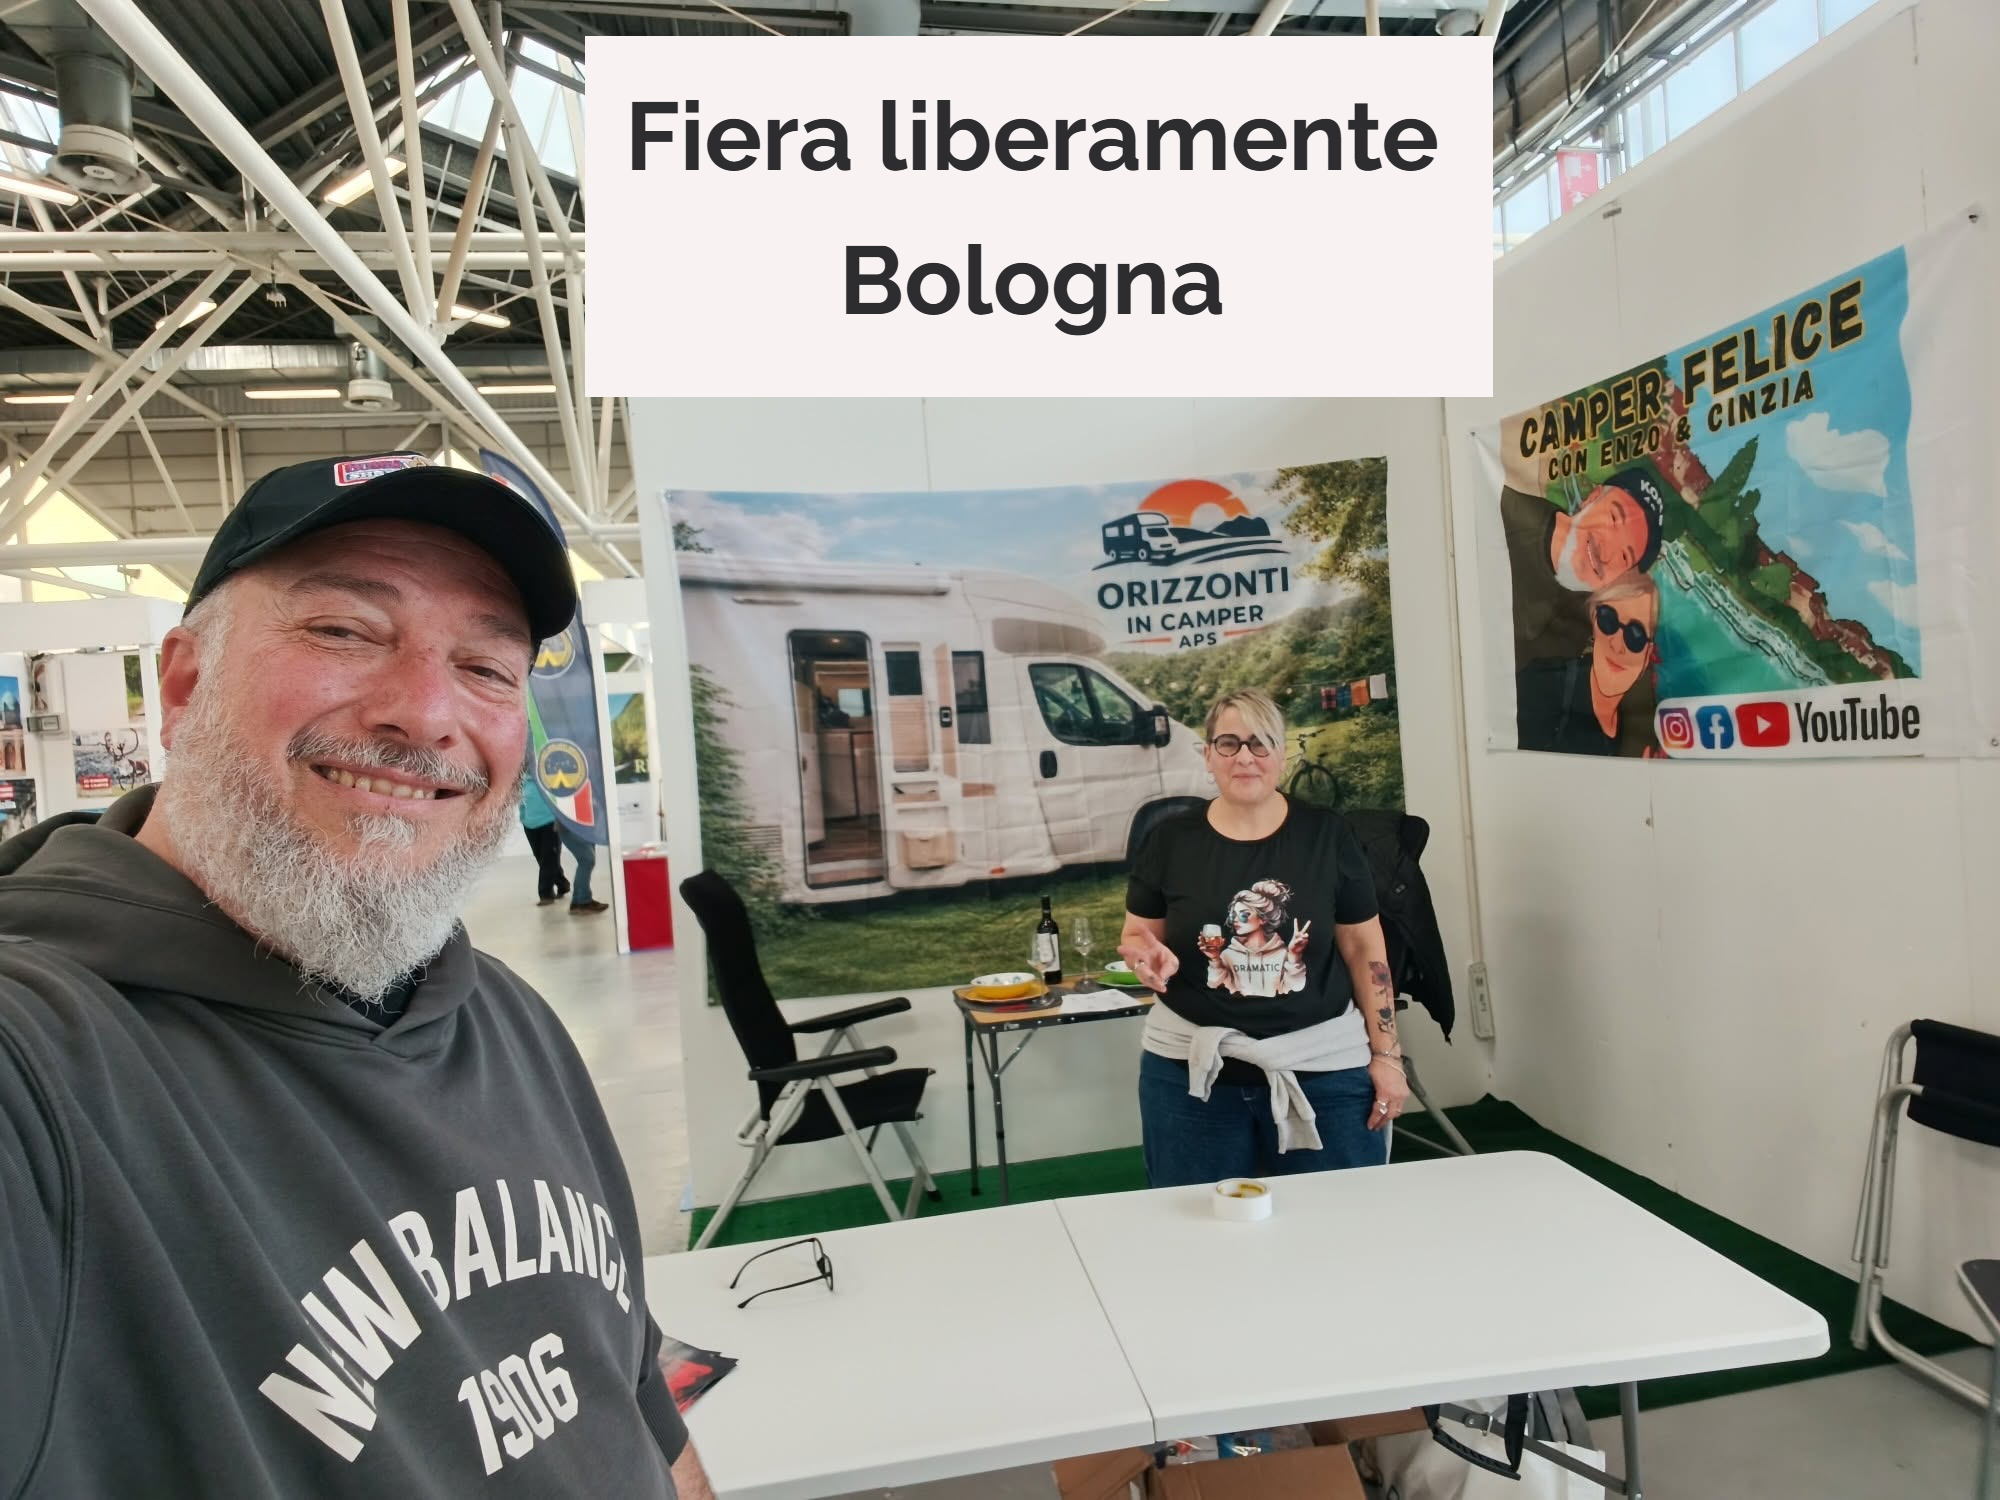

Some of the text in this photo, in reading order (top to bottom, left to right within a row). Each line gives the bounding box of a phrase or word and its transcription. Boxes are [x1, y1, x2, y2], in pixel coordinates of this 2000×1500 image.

[1519, 279, 1864, 459] CAMPER FELICE
[1548, 369, 1815, 481] CON ENZO & CINZIA
[1097, 566, 1290, 610] ORIZZONTI
[1127, 604, 1265, 635] IN CAMPER
[1179, 631, 1218, 649] APS
[1795, 693, 1921, 744] YouTube
[1232, 963, 1281, 973] DRAMATIC
[258, 1238, 423, 1464] NW
[457, 1332, 579, 1477] 1906
